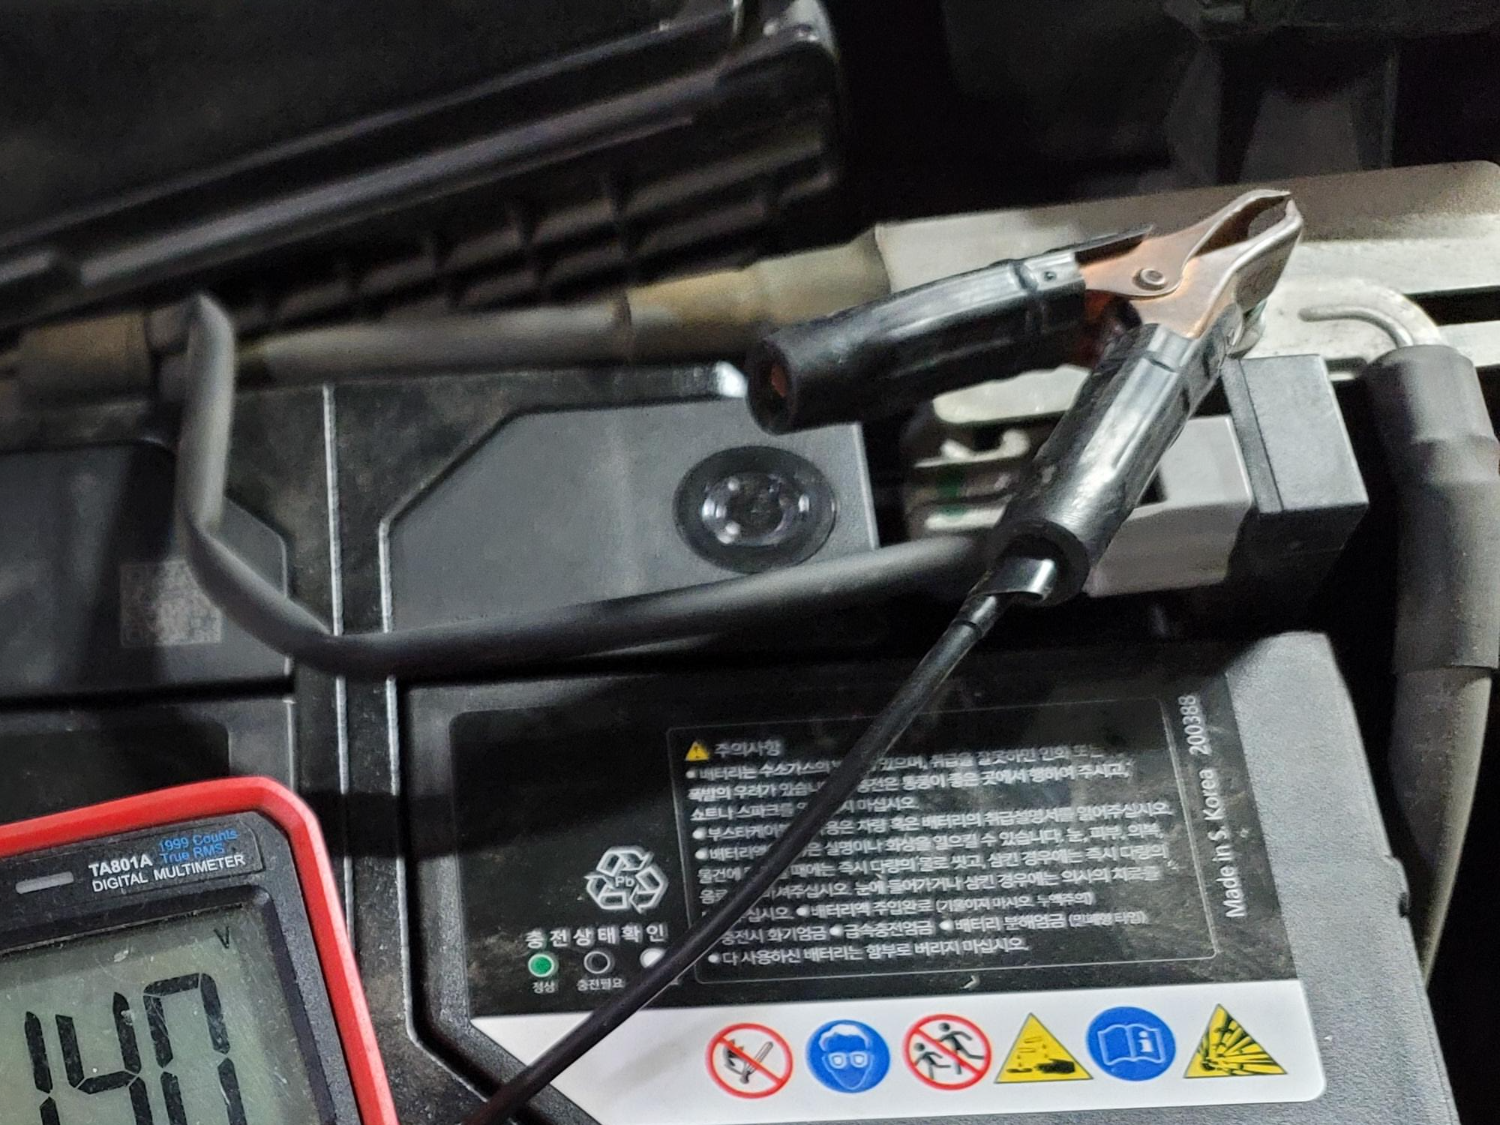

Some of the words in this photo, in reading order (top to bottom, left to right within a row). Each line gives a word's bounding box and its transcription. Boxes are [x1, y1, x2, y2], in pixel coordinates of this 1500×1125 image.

[1178, 694, 1212, 756] 200388
[714, 740, 781, 758] 주의사항
[700, 765, 757, 780] 배터리는
[930, 752, 974, 769] 취급을
[734, 784, 777, 799] 우려가
[1199, 768, 1226, 821] Korea
[857, 818, 887, 834] 차량
[922, 812, 982, 829] 배터리의
[1207, 826, 1231, 842] S.
[981, 832, 998, 847] 수
[88, 854, 153, 877] TA801A
[159, 835, 190, 852] 1999
[192, 828, 240, 846] Counts
[159, 850, 190, 864] True
[193, 843, 226, 859] RMS
[870, 857, 916, 875] 다량의
[1022, 848, 1084, 865] 경우에는
[1212, 843, 1234, 862] in
[92, 871, 148, 893] DIGITAL
[153, 854, 247, 881] MULTIMETER
[614, 875, 636, 888] Pb
[998, 872, 1060, 889] 경우에는
[1061, 868, 1111, 884] 의사의
[1216, 865, 1247, 918] Made
[212, 926, 231, 949] V
[526, 923, 666, 948] 충전상태확인
[768, 925, 827, 942] 화기엄금
[844, 920, 935, 939] 급속충전엄금
[955, 915, 1001, 932] 배터리
[721, 950, 739, 966] 다
[741, 948, 802, 965] 사용하신
[803, 944, 864, 962] 배터리는
[865, 942, 913, 960] 함부로
[914, 940, 961, 957] 버리지
